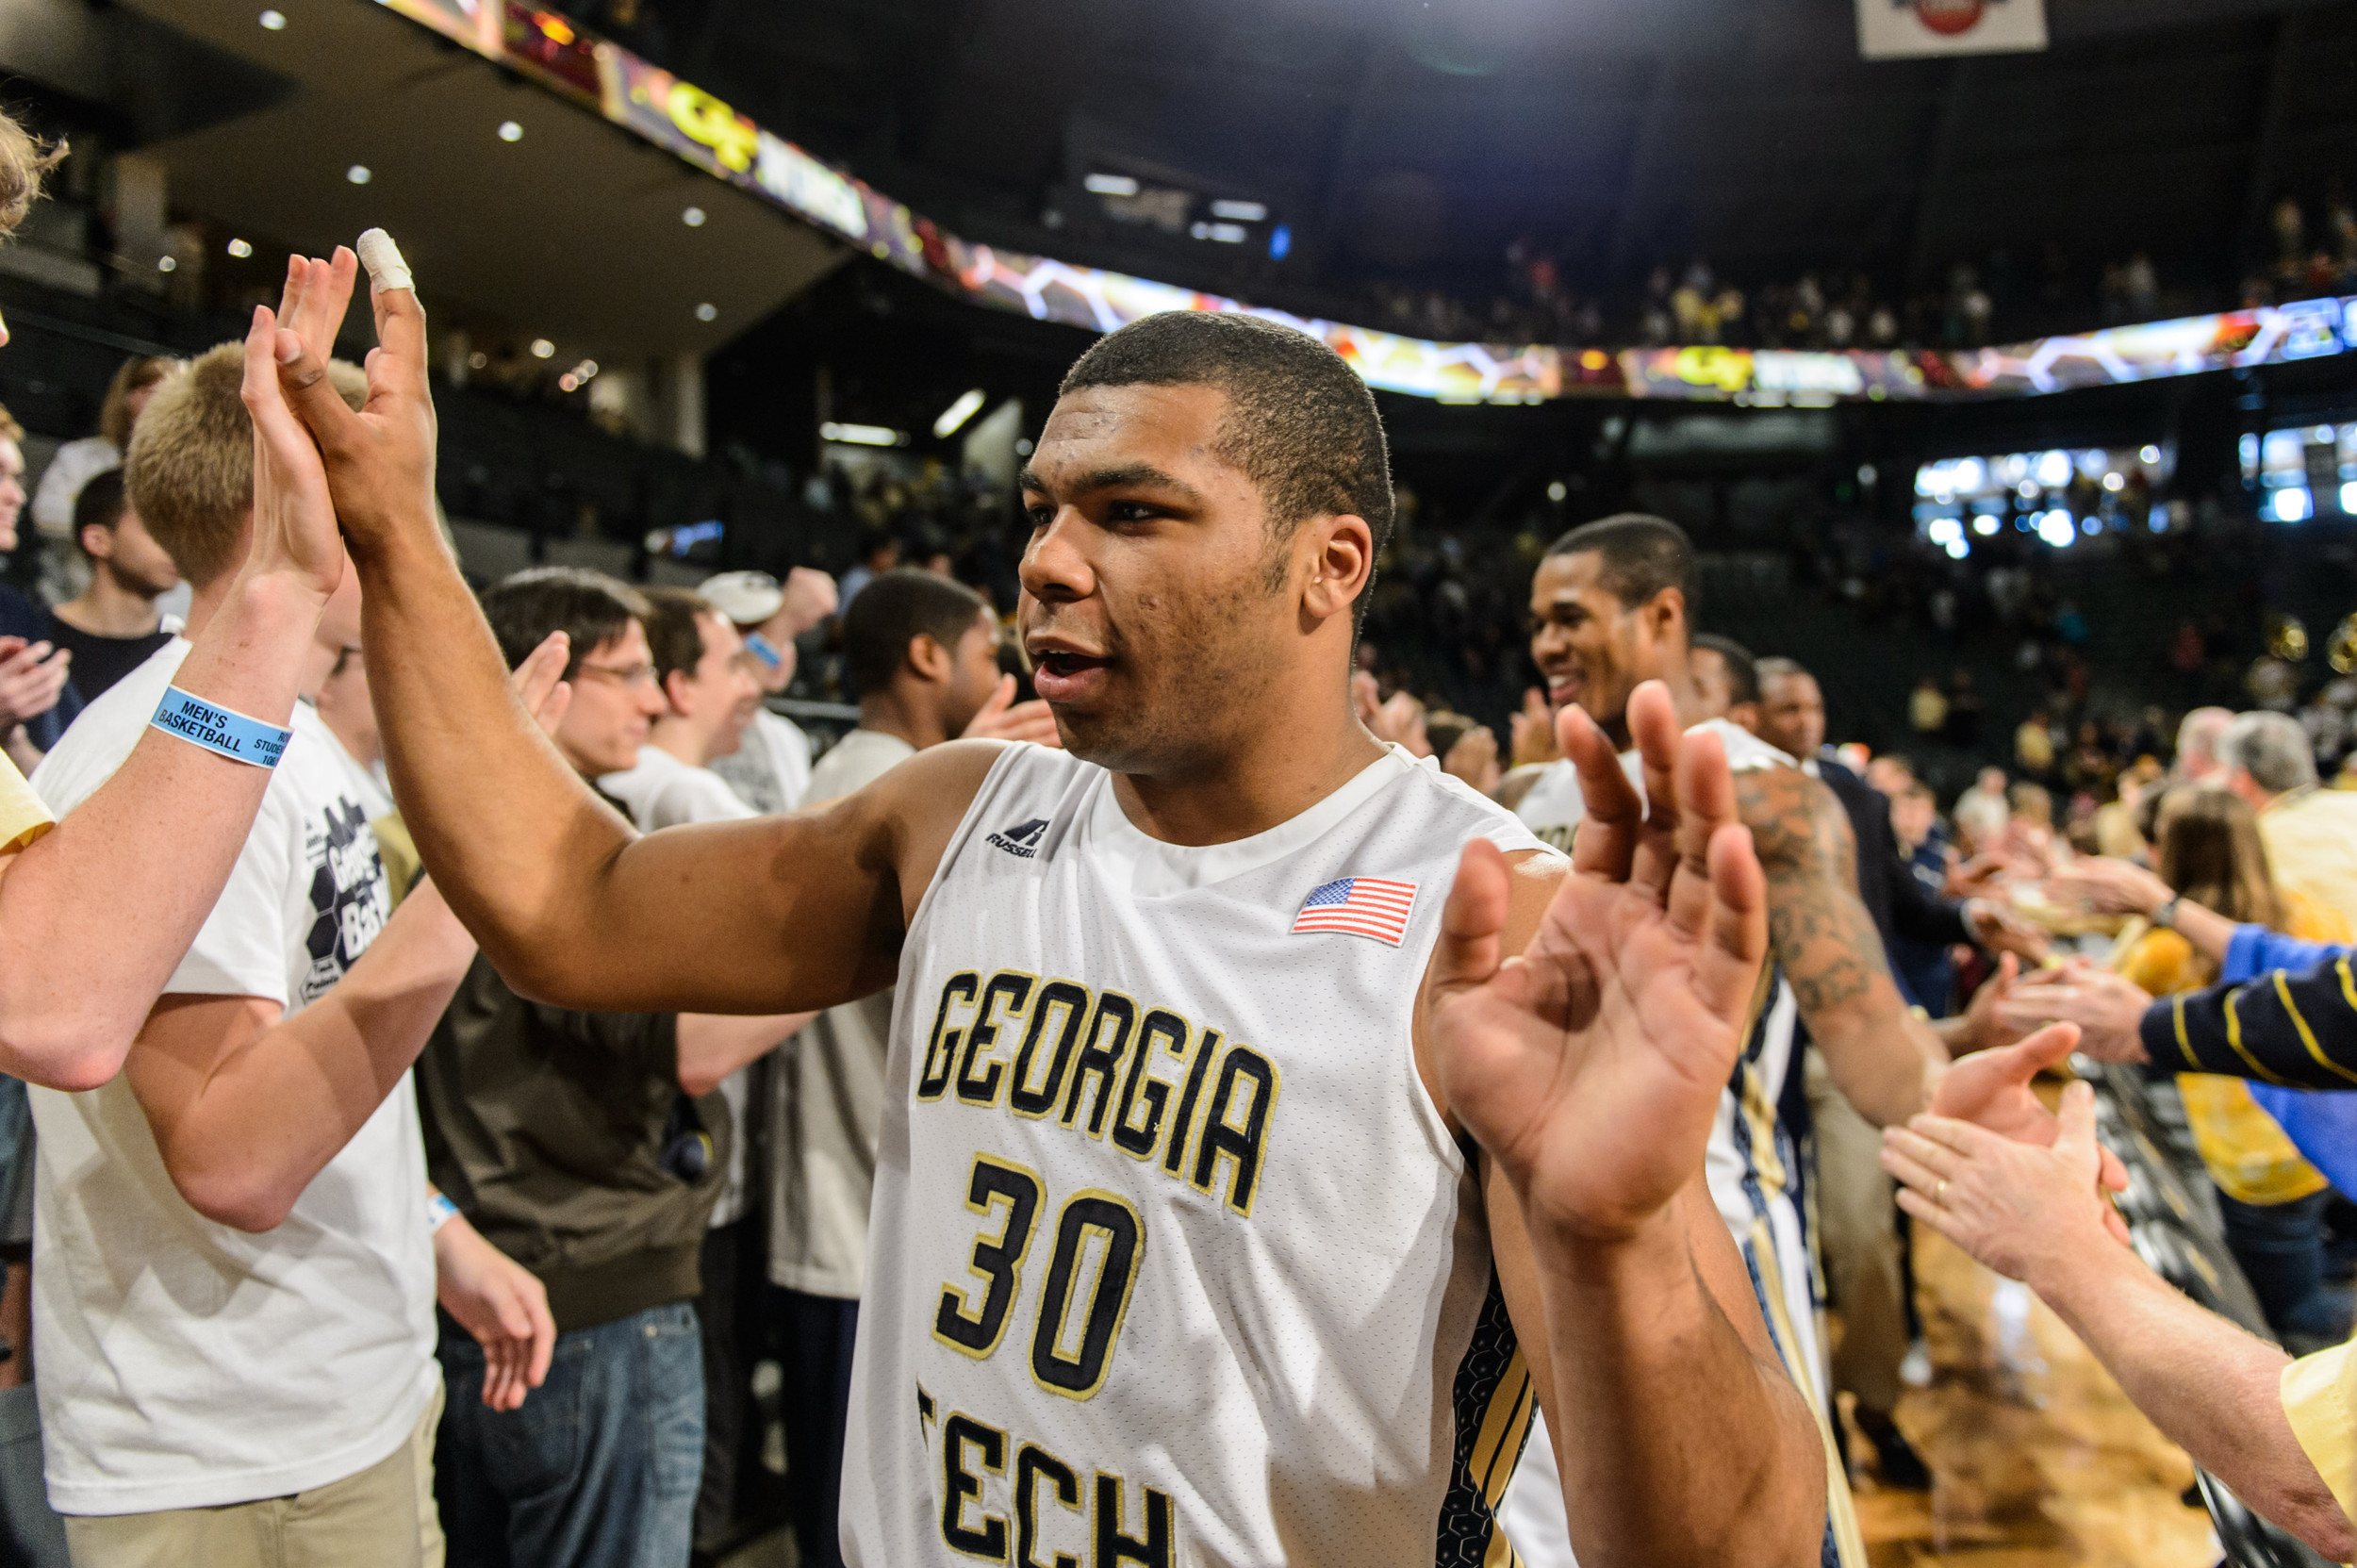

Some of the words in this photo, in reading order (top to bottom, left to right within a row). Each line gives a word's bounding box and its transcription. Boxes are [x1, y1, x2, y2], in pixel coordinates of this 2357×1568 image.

[157, 709, 241, 752] BASKETBALL
[181, 701, 228, 729] MEN'S
[916, 967, 1282, 1218] GEORGIA
[932, 1151, 1147, 1402] 30
